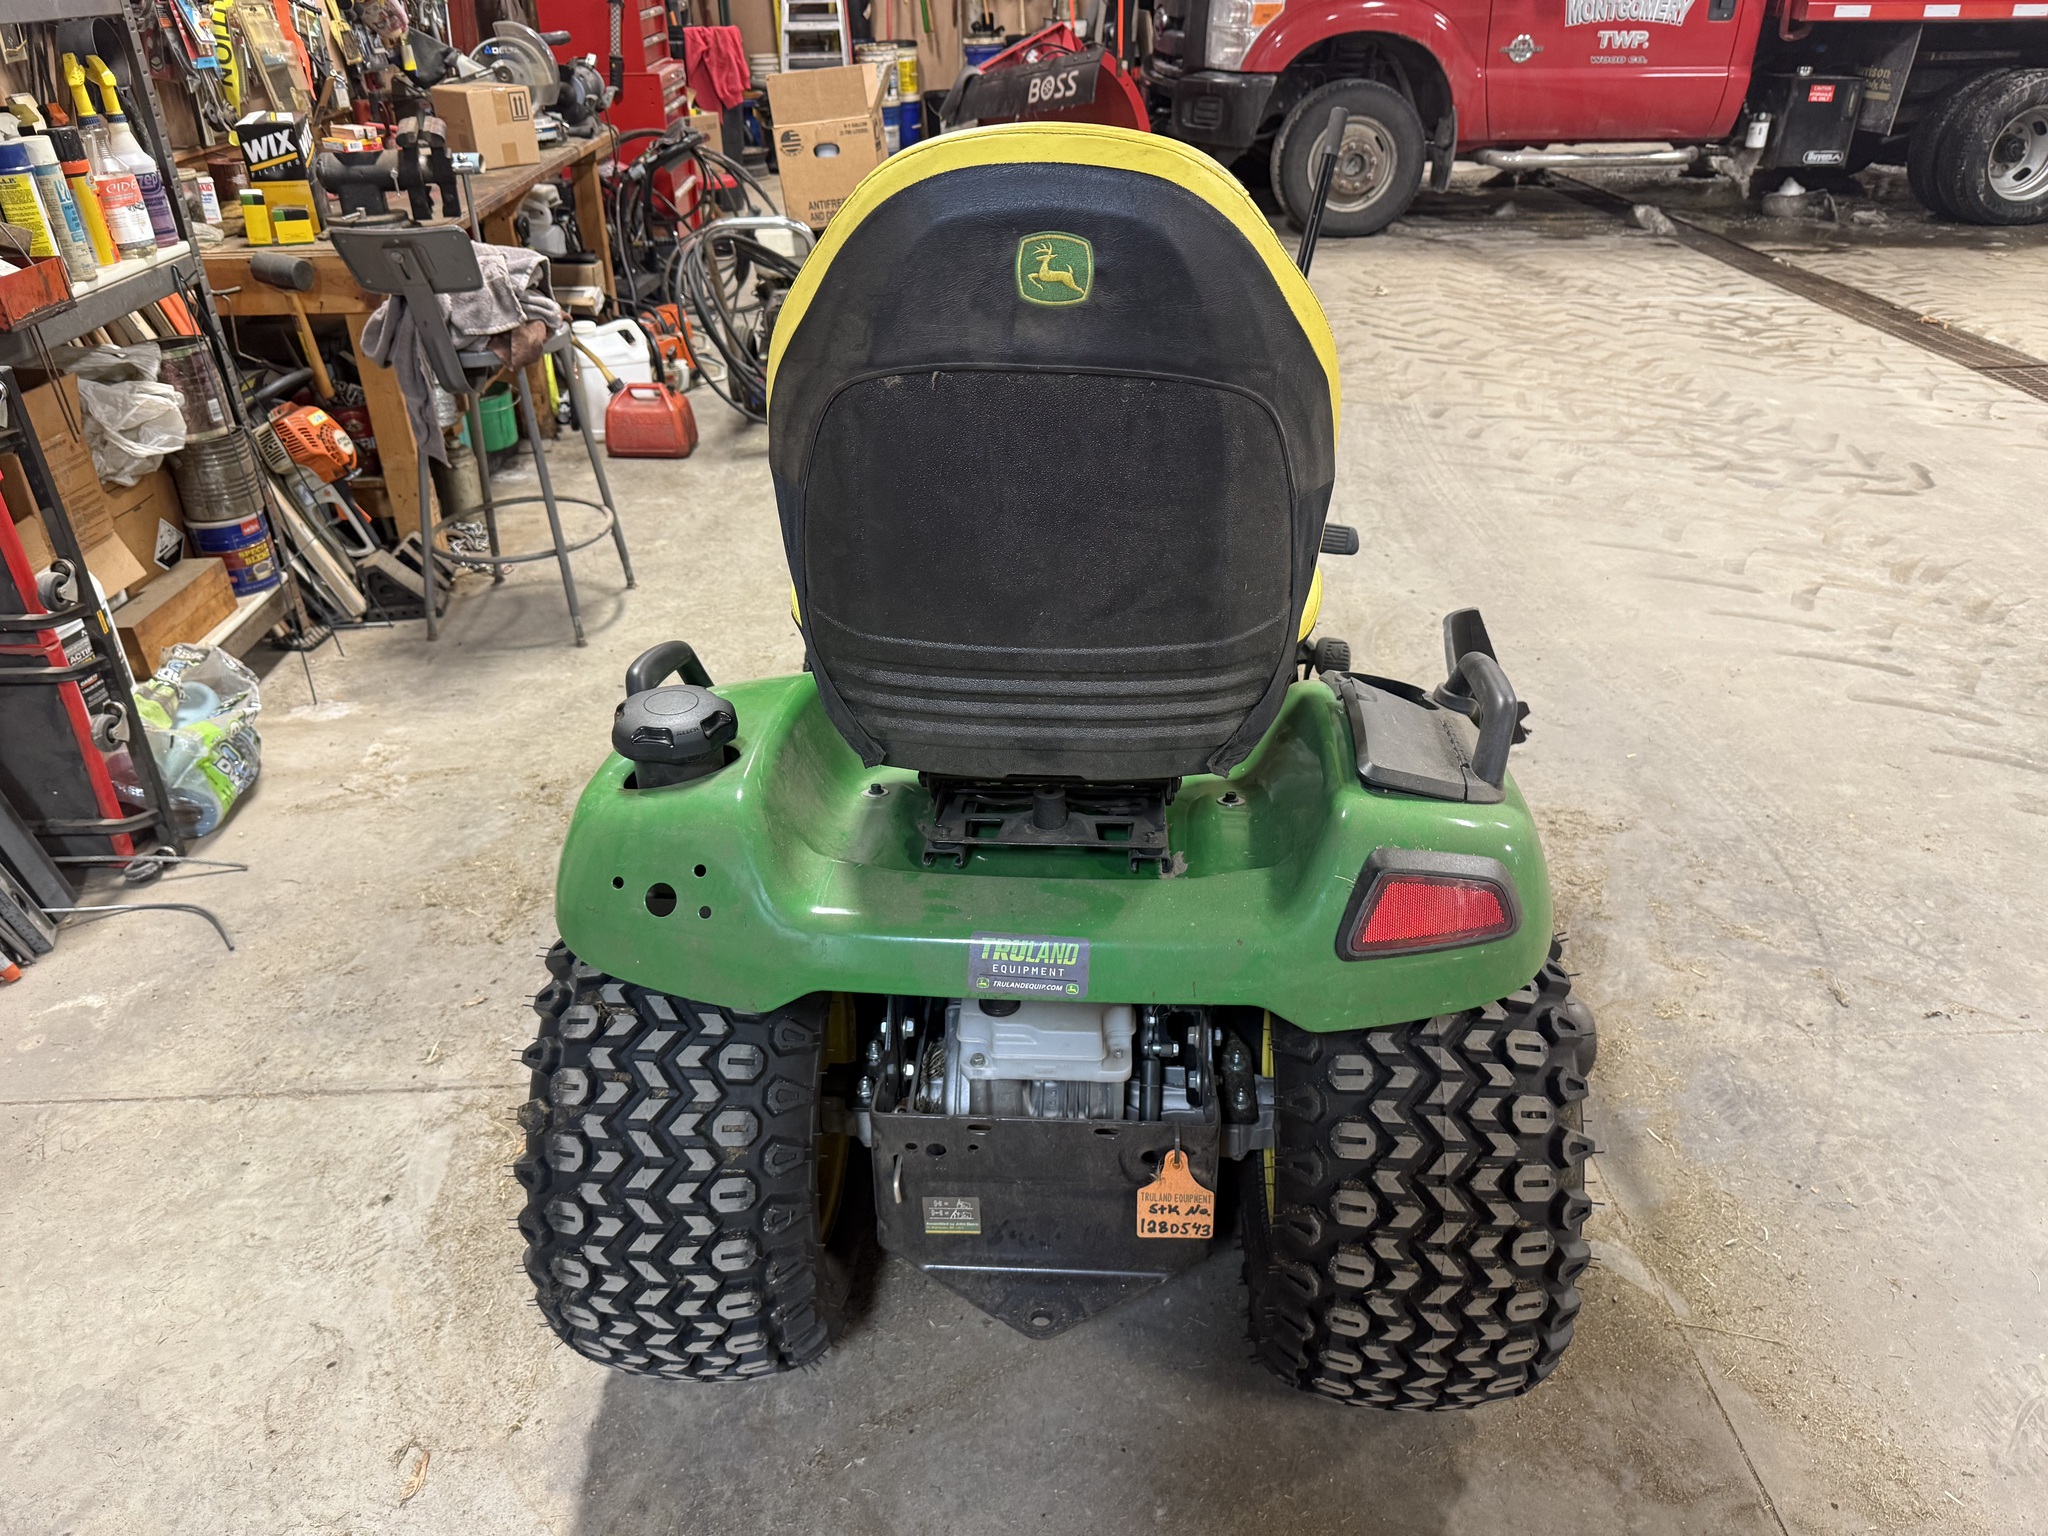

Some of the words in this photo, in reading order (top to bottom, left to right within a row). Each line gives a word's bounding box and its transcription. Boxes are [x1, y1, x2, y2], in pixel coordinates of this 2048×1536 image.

[1565, 0, 1695, 27] MONTGOMERY
[1597, 30, 1649, 49] TWP.
[1590, 56, 1625, 64] WOOD
[1028, 70, 1079, 104] BOSS
[242, 128, 297, 164] WIX
[251, 159, 300, 178] FILTERS
[808, 198, 847, 211] ANTIFRE
[810, 213, 825, 221] AND
[981, 937, 1079, 965] TRULAND
[992, 964, 1065, 977] EQUIPMENT
[993, 980, 1063, 991] TRULANDEQUIP.COM
[1141, 1192, 1172, 1202] TRULAND
[1174, 1193, 1212, 1203] EQUIPMENT
[1140, 1218, 1211, 1237] 1280543
